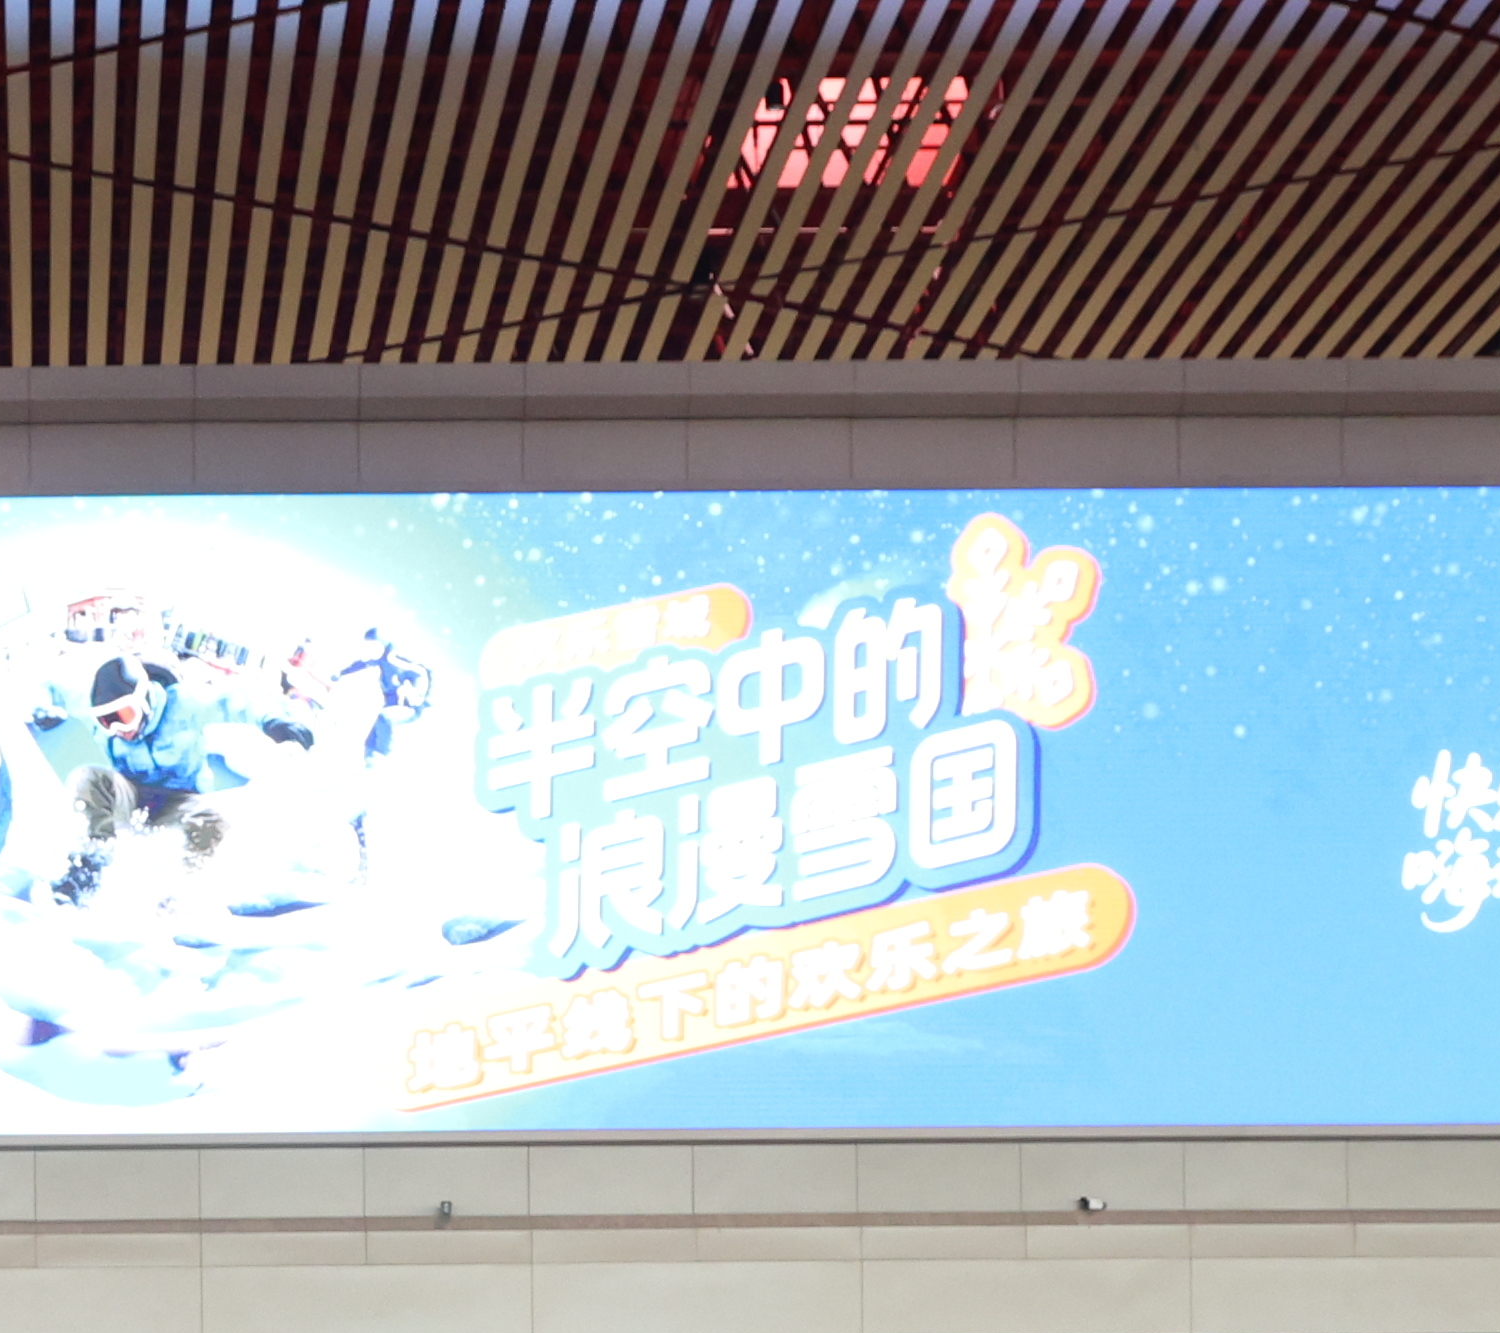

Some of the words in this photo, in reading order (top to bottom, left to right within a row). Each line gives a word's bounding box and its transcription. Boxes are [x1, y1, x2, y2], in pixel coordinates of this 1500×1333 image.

[487, 597, 947, 820] 半空中的
[552, 717, 1019, 957] 浪漫雪国
[405, 889, 1091, 1093] 地平线下的欢乐之旅
